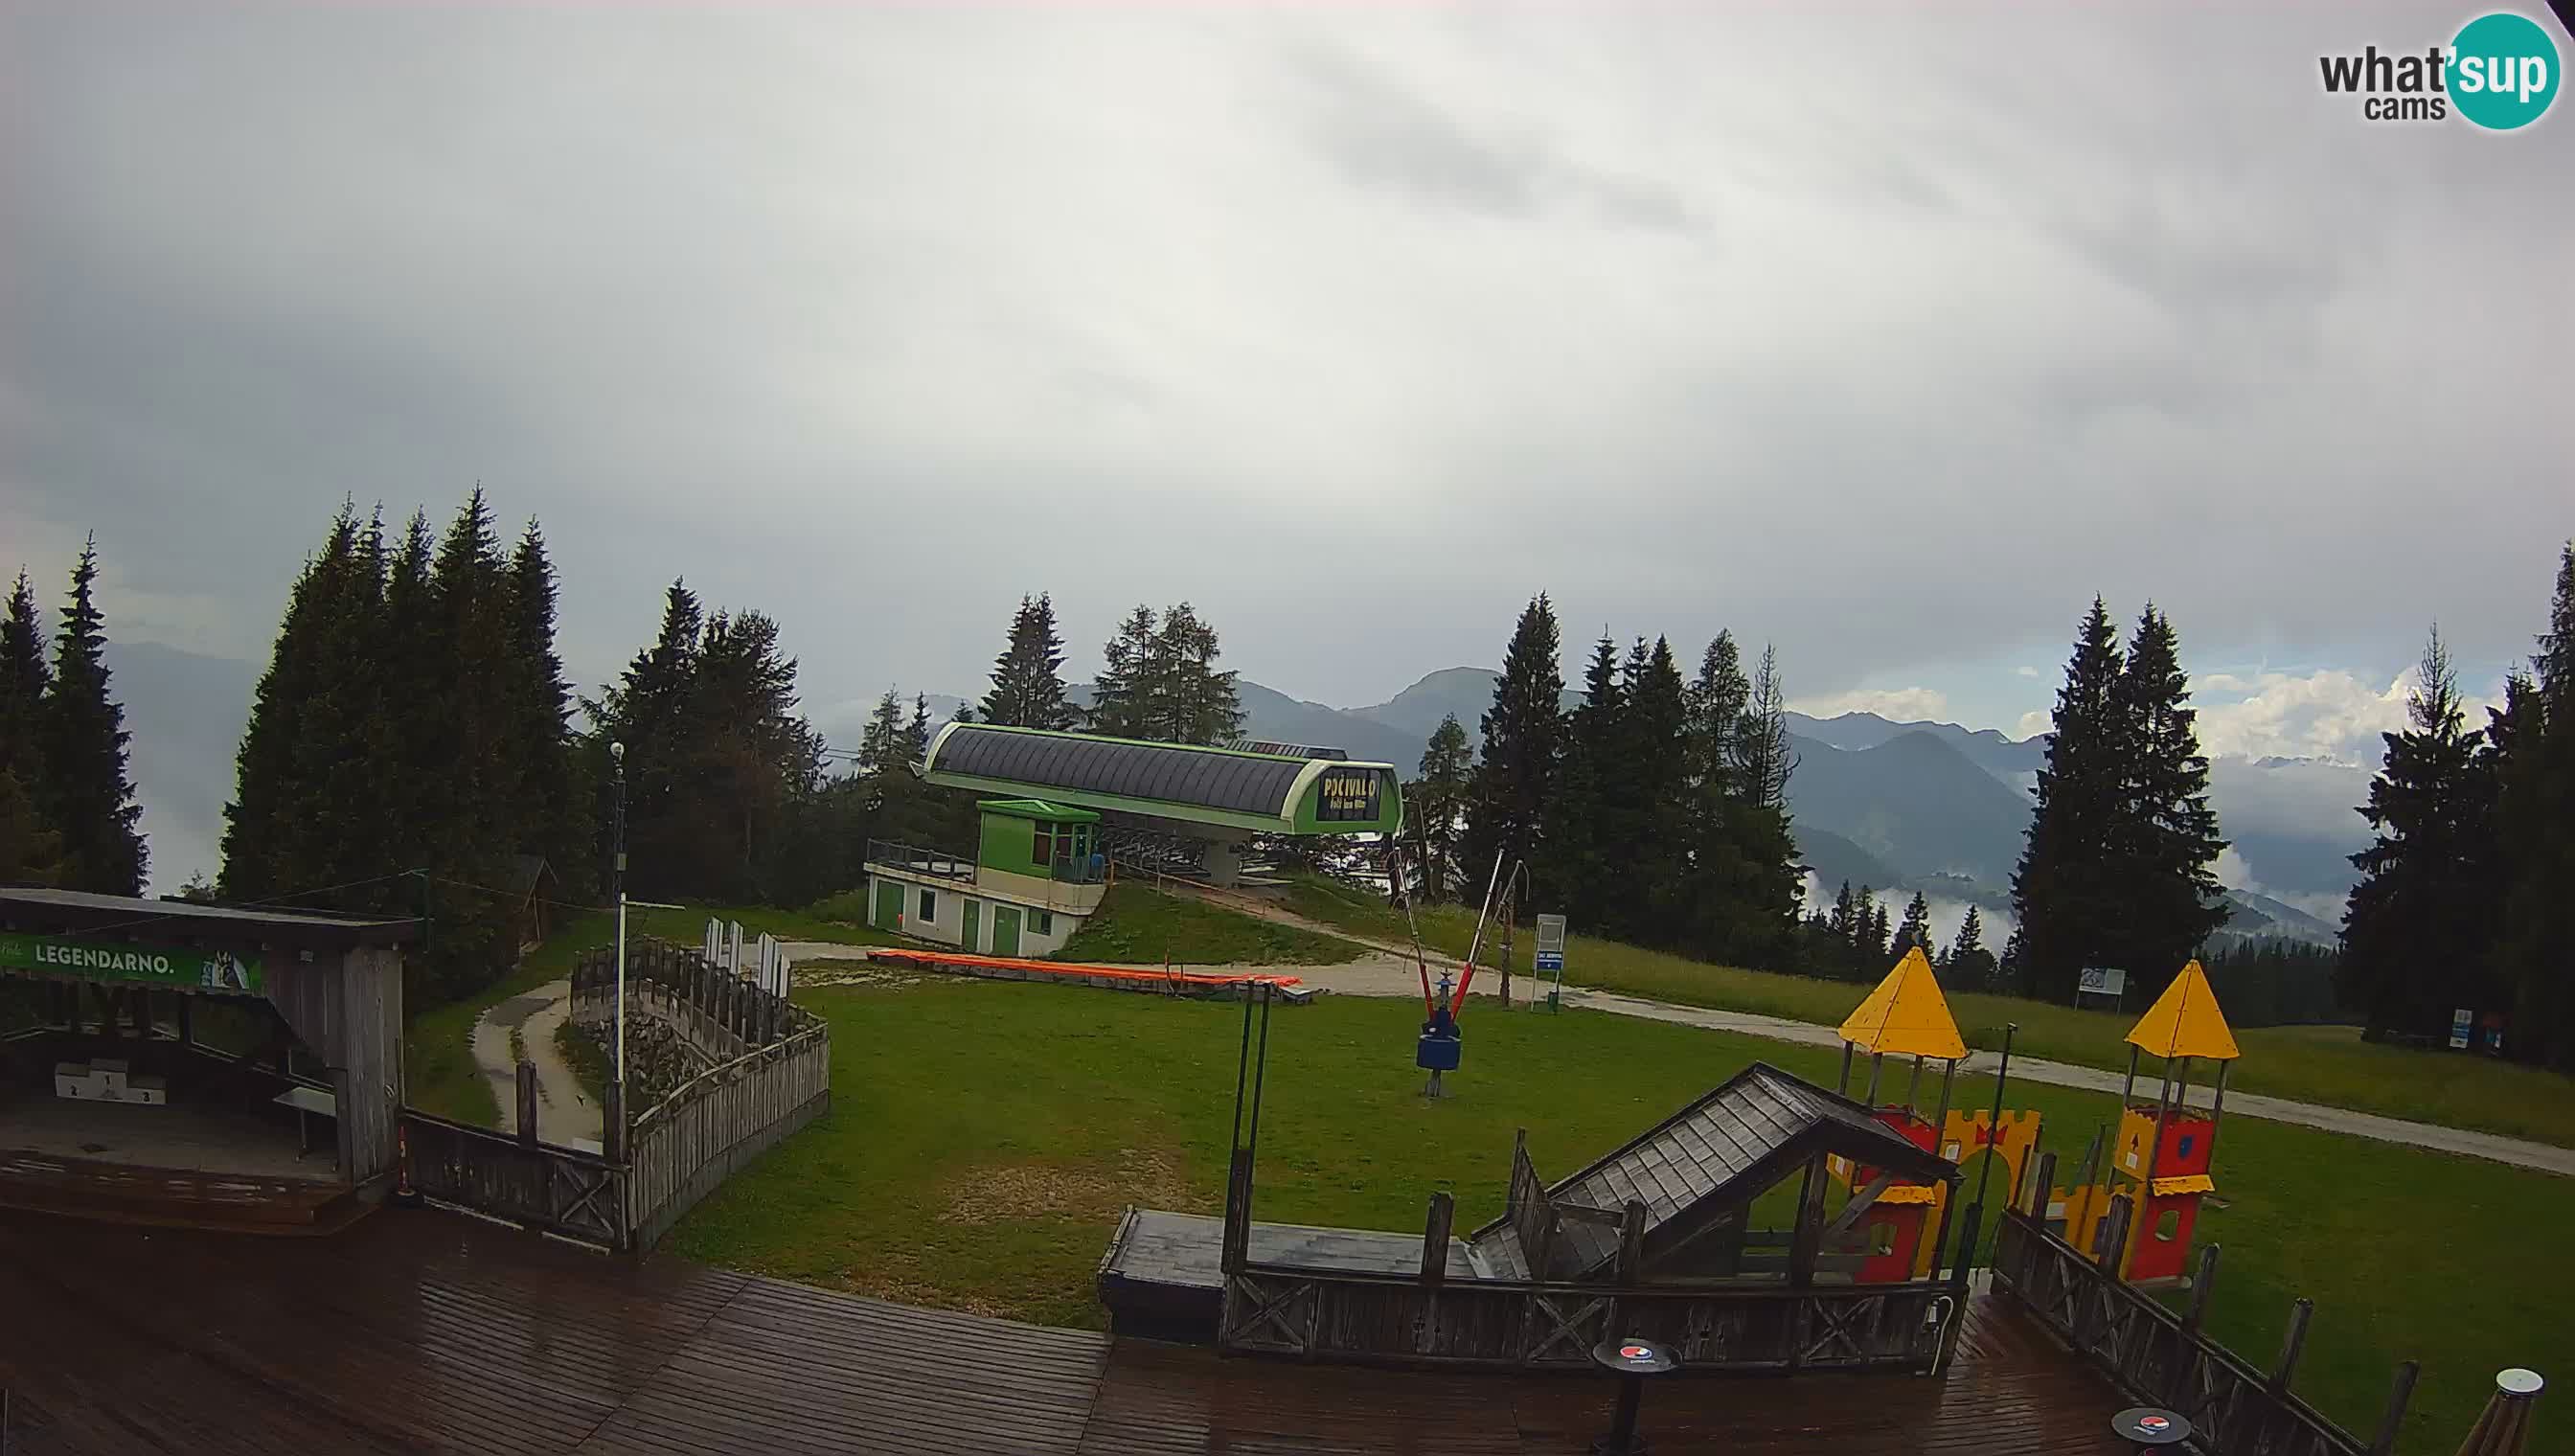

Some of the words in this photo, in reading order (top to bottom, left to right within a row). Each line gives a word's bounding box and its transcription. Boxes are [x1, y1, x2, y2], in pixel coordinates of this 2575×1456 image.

[35, 944, 174, 974] LEGENDARNO.
[70, 1084, 78, 1096] 2
[143, 1091, 150, 1102] 3
